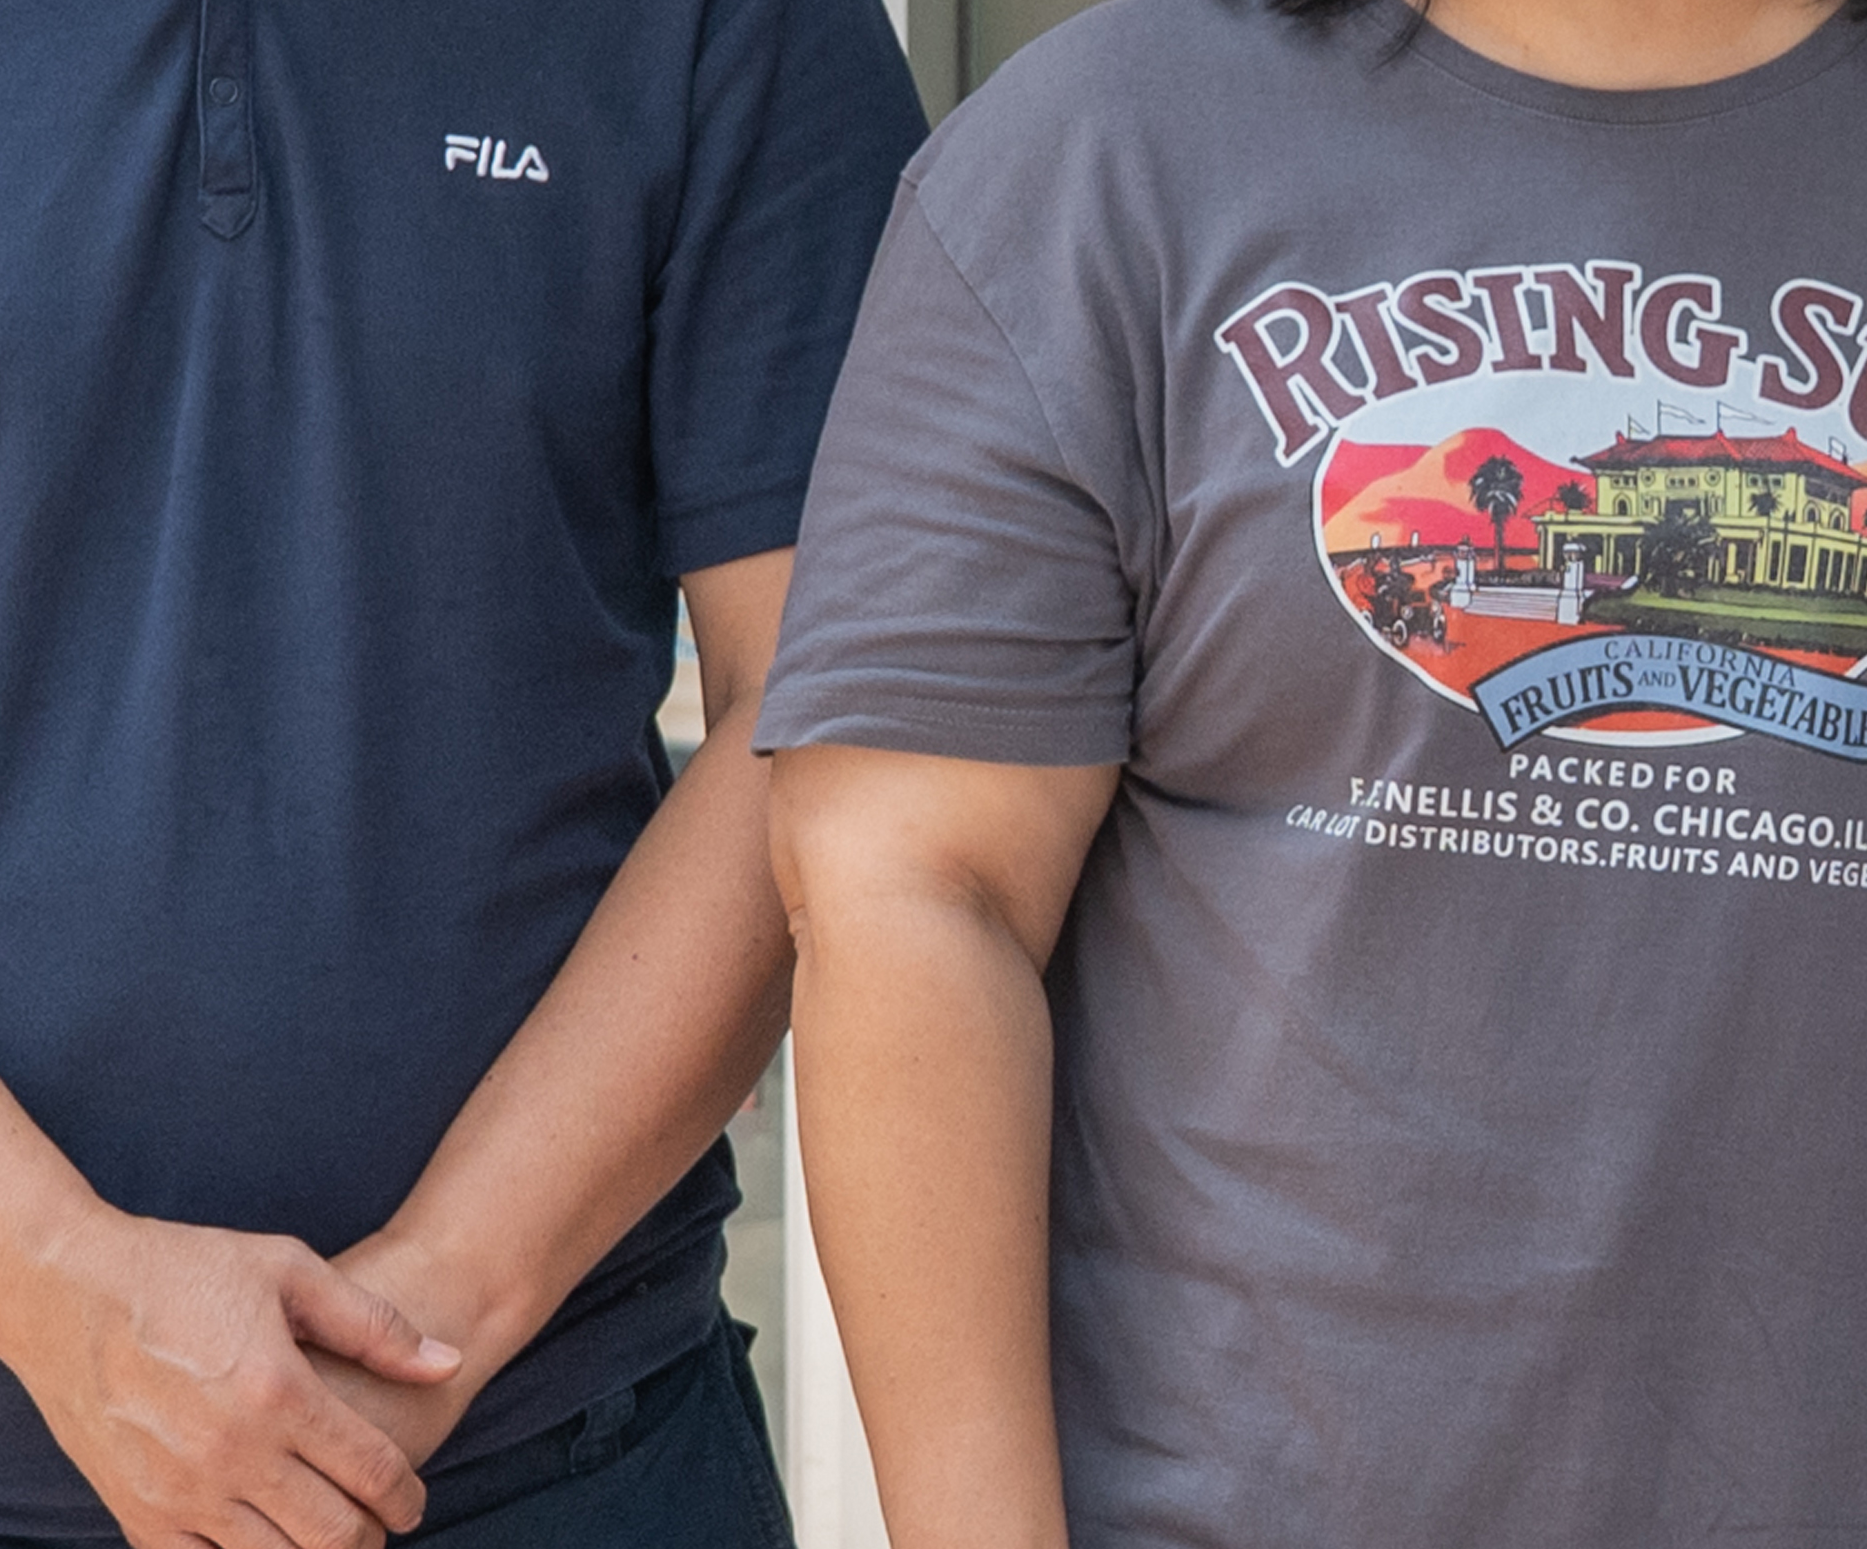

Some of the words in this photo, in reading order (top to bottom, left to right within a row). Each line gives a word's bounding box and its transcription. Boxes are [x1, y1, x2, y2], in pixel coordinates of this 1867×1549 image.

[444, 134, 550, 183] FILA
[1214, 260, 1749, 467] RISING
[1603, 639, 1796, 687] CALIFORNIA
[1499, 660, 1635, 735] FRUITS
[1637, 670, 1677, 688] AND
[1509, 753, 1655, 790] PACKED
[1664, 764, 1737, 795] FOR
[1530, 793, 1563, 827] &
[1575, 798, 1640, 833] CO.
[1727, 851, 1801, 882] AND
